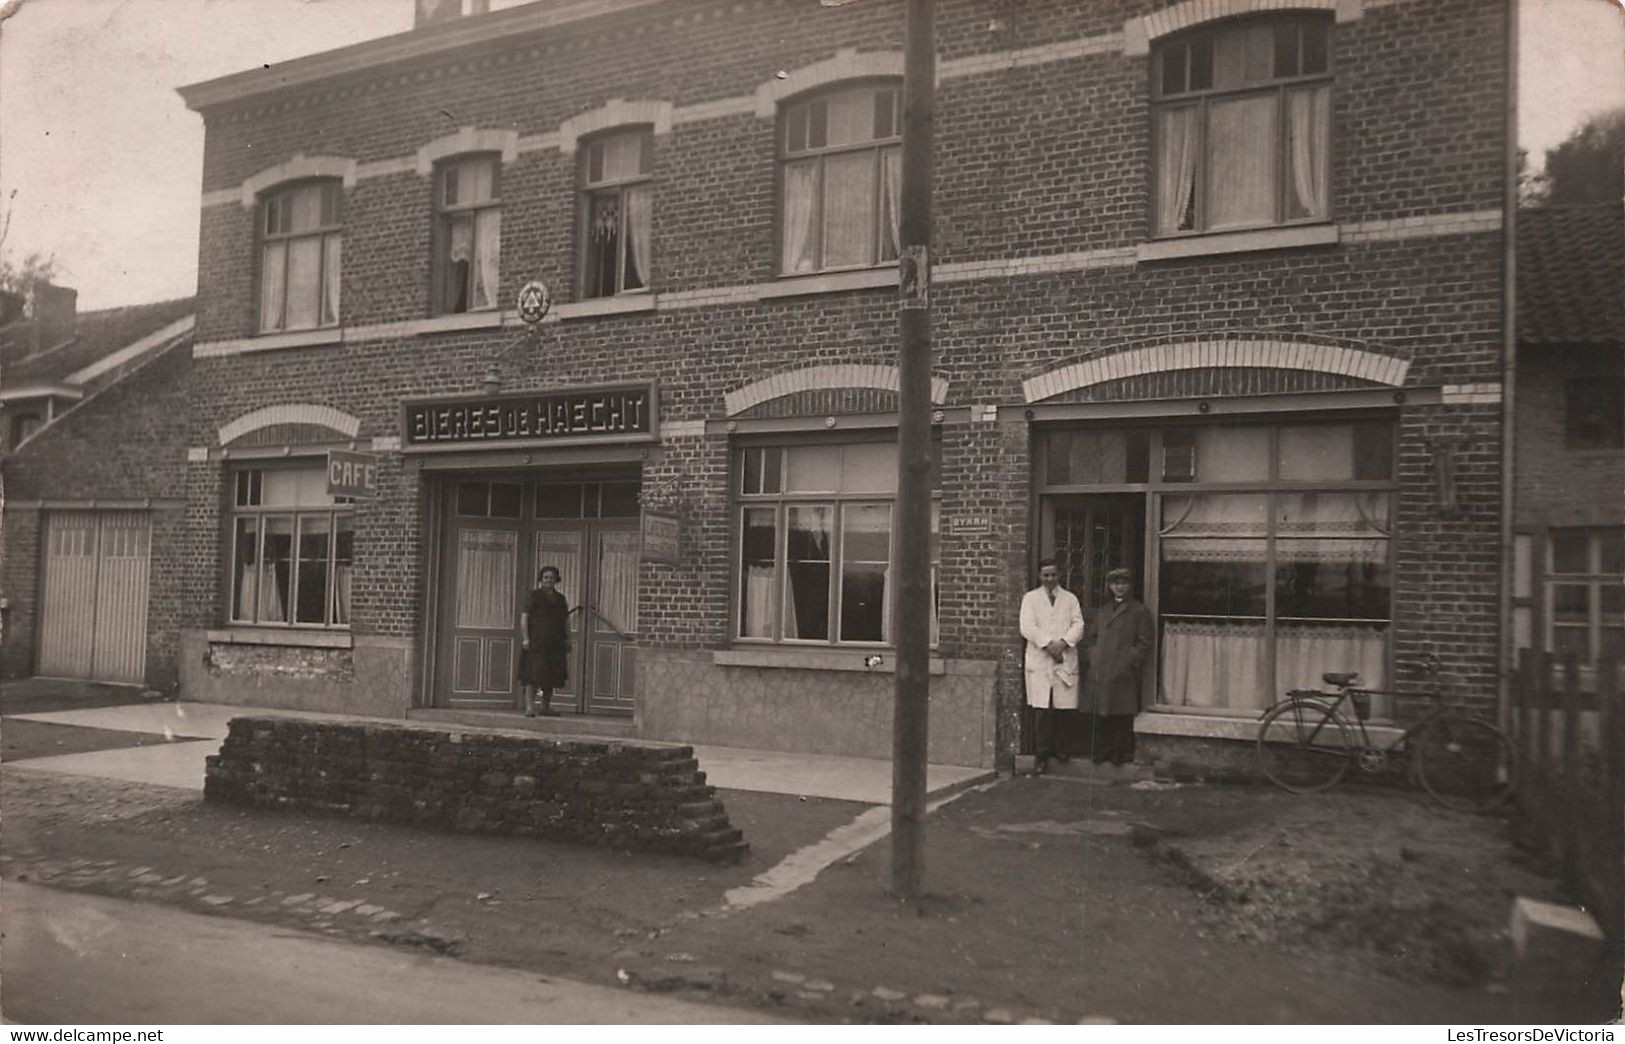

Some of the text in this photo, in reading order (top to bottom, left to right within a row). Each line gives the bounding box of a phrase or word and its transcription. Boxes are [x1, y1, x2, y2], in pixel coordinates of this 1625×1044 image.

[414, 396, 643, 439] BIERES DE HAECHT
[330, 460, 375, 489] CAFE
